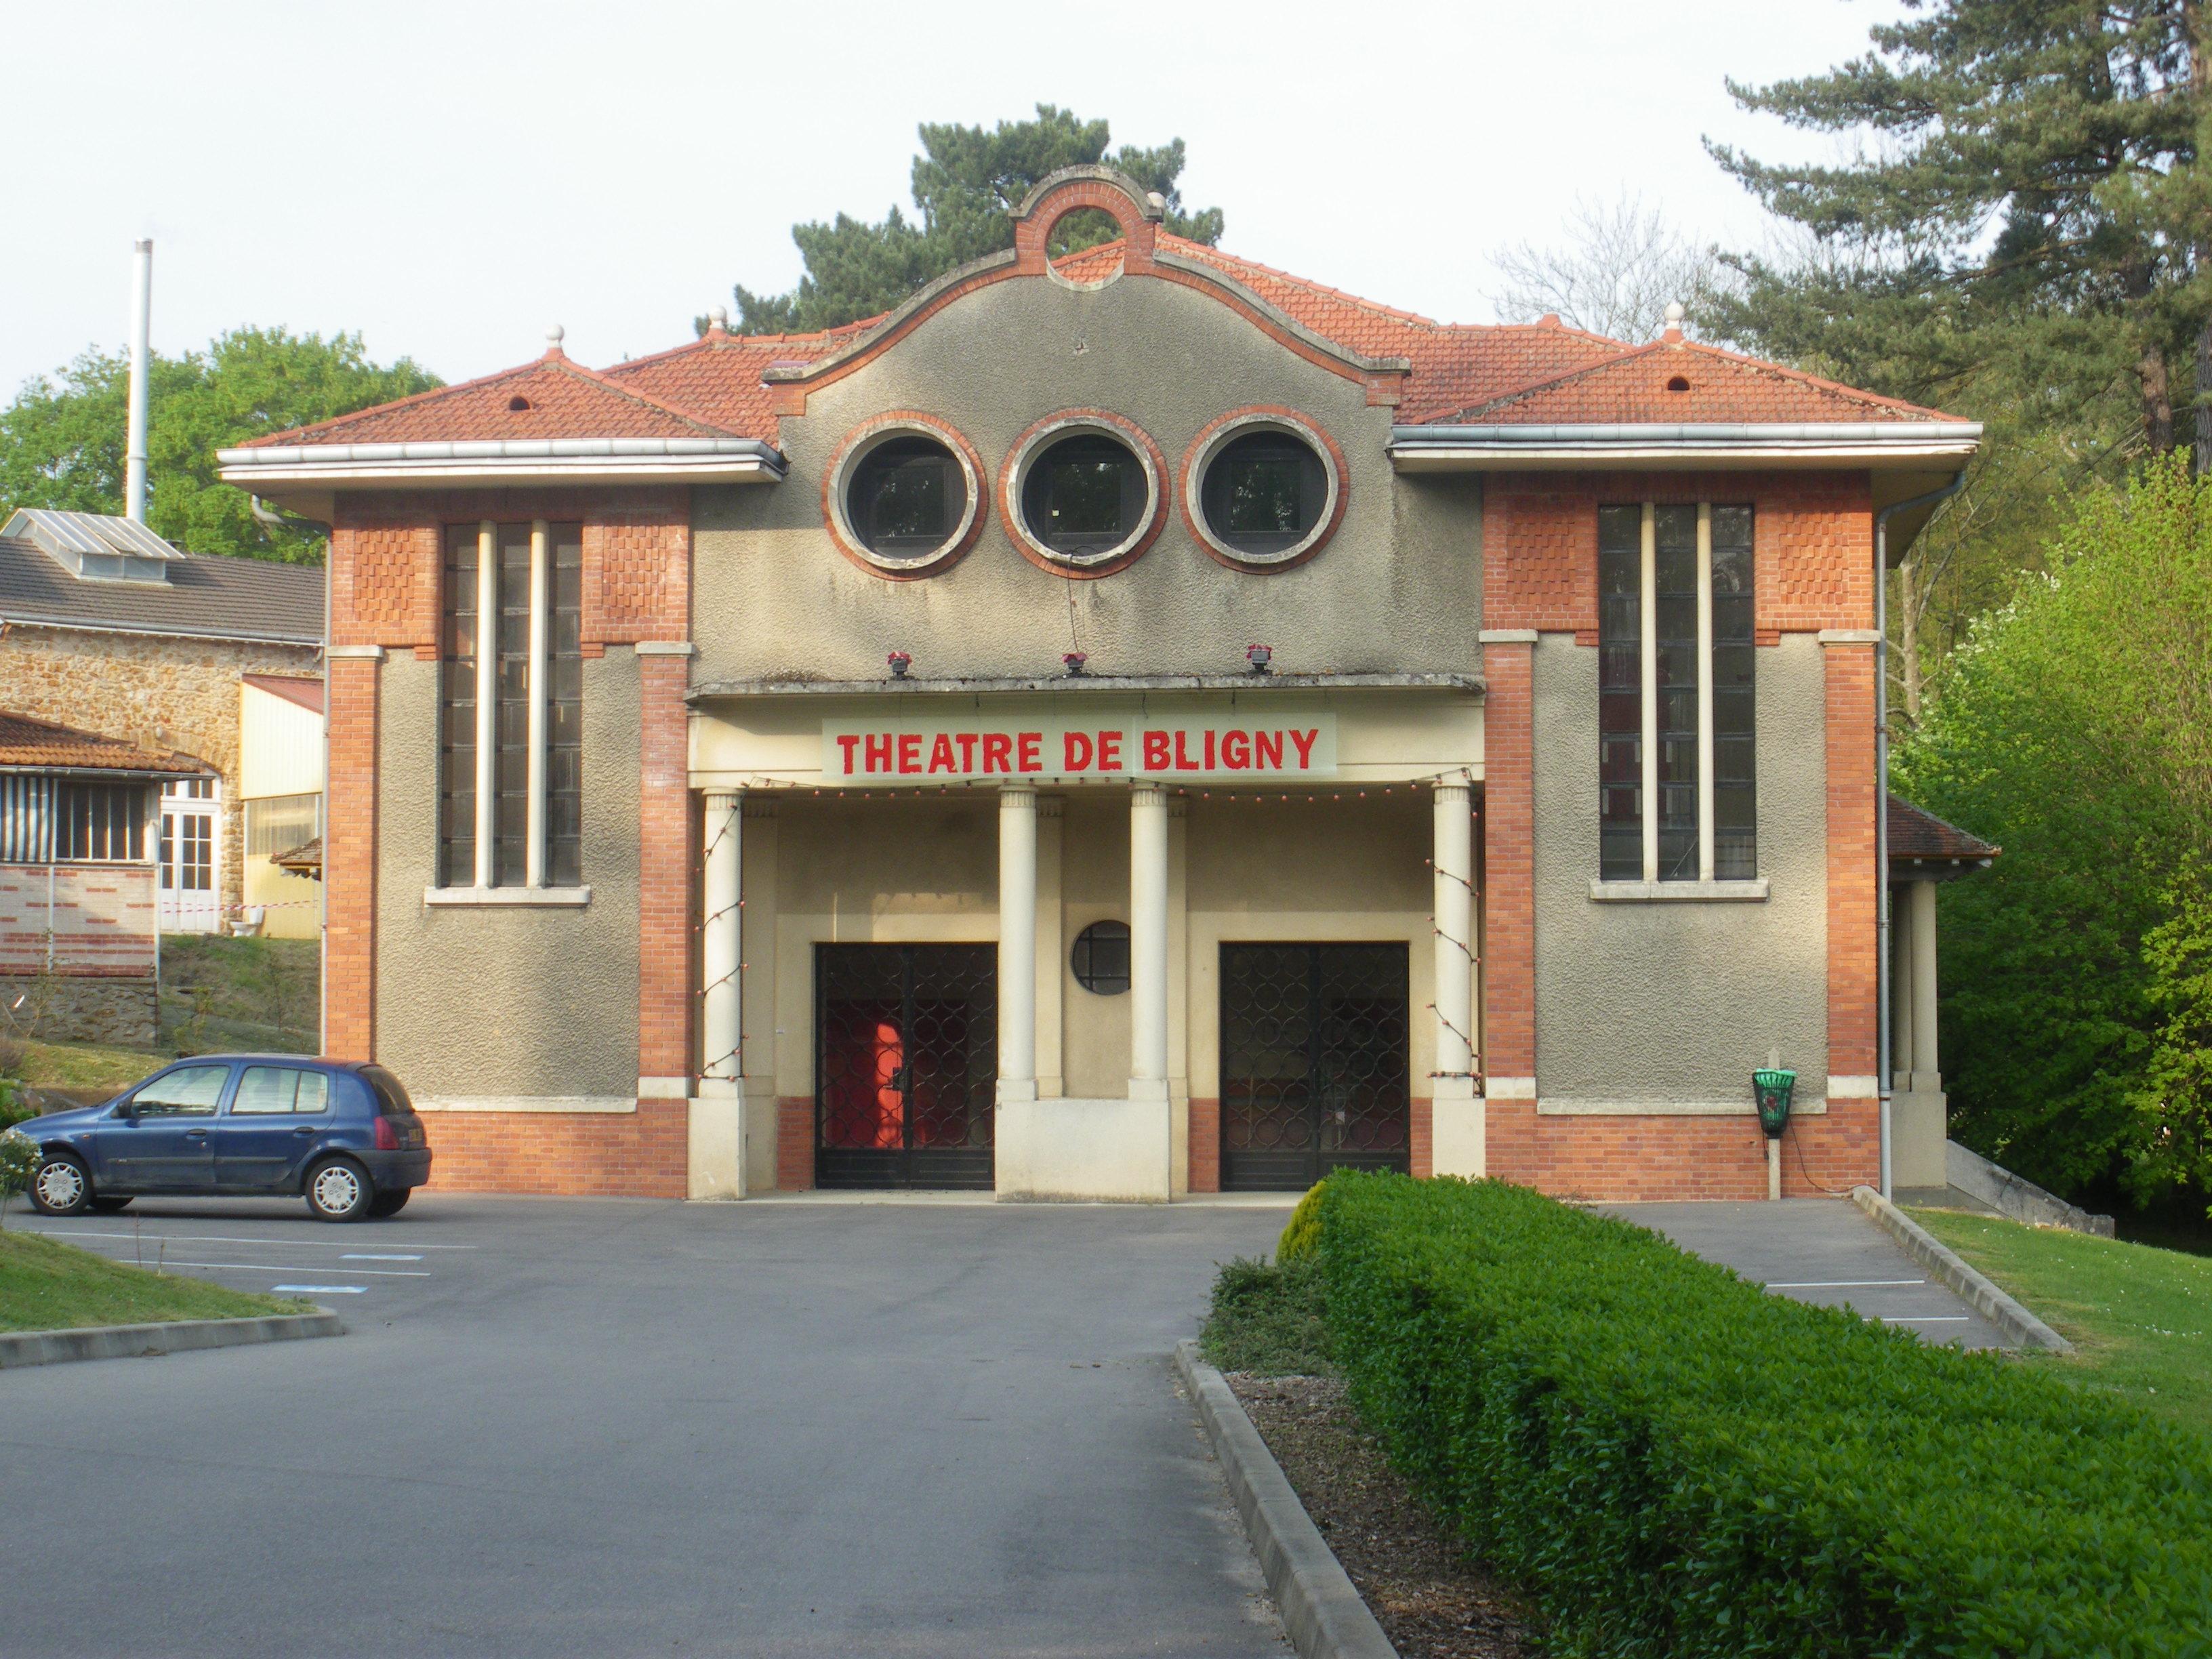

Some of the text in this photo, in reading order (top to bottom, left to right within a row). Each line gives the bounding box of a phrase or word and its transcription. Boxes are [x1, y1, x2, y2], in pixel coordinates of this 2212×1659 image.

[836, 729, 1319, 775] THEATRE DE BLIGNY
